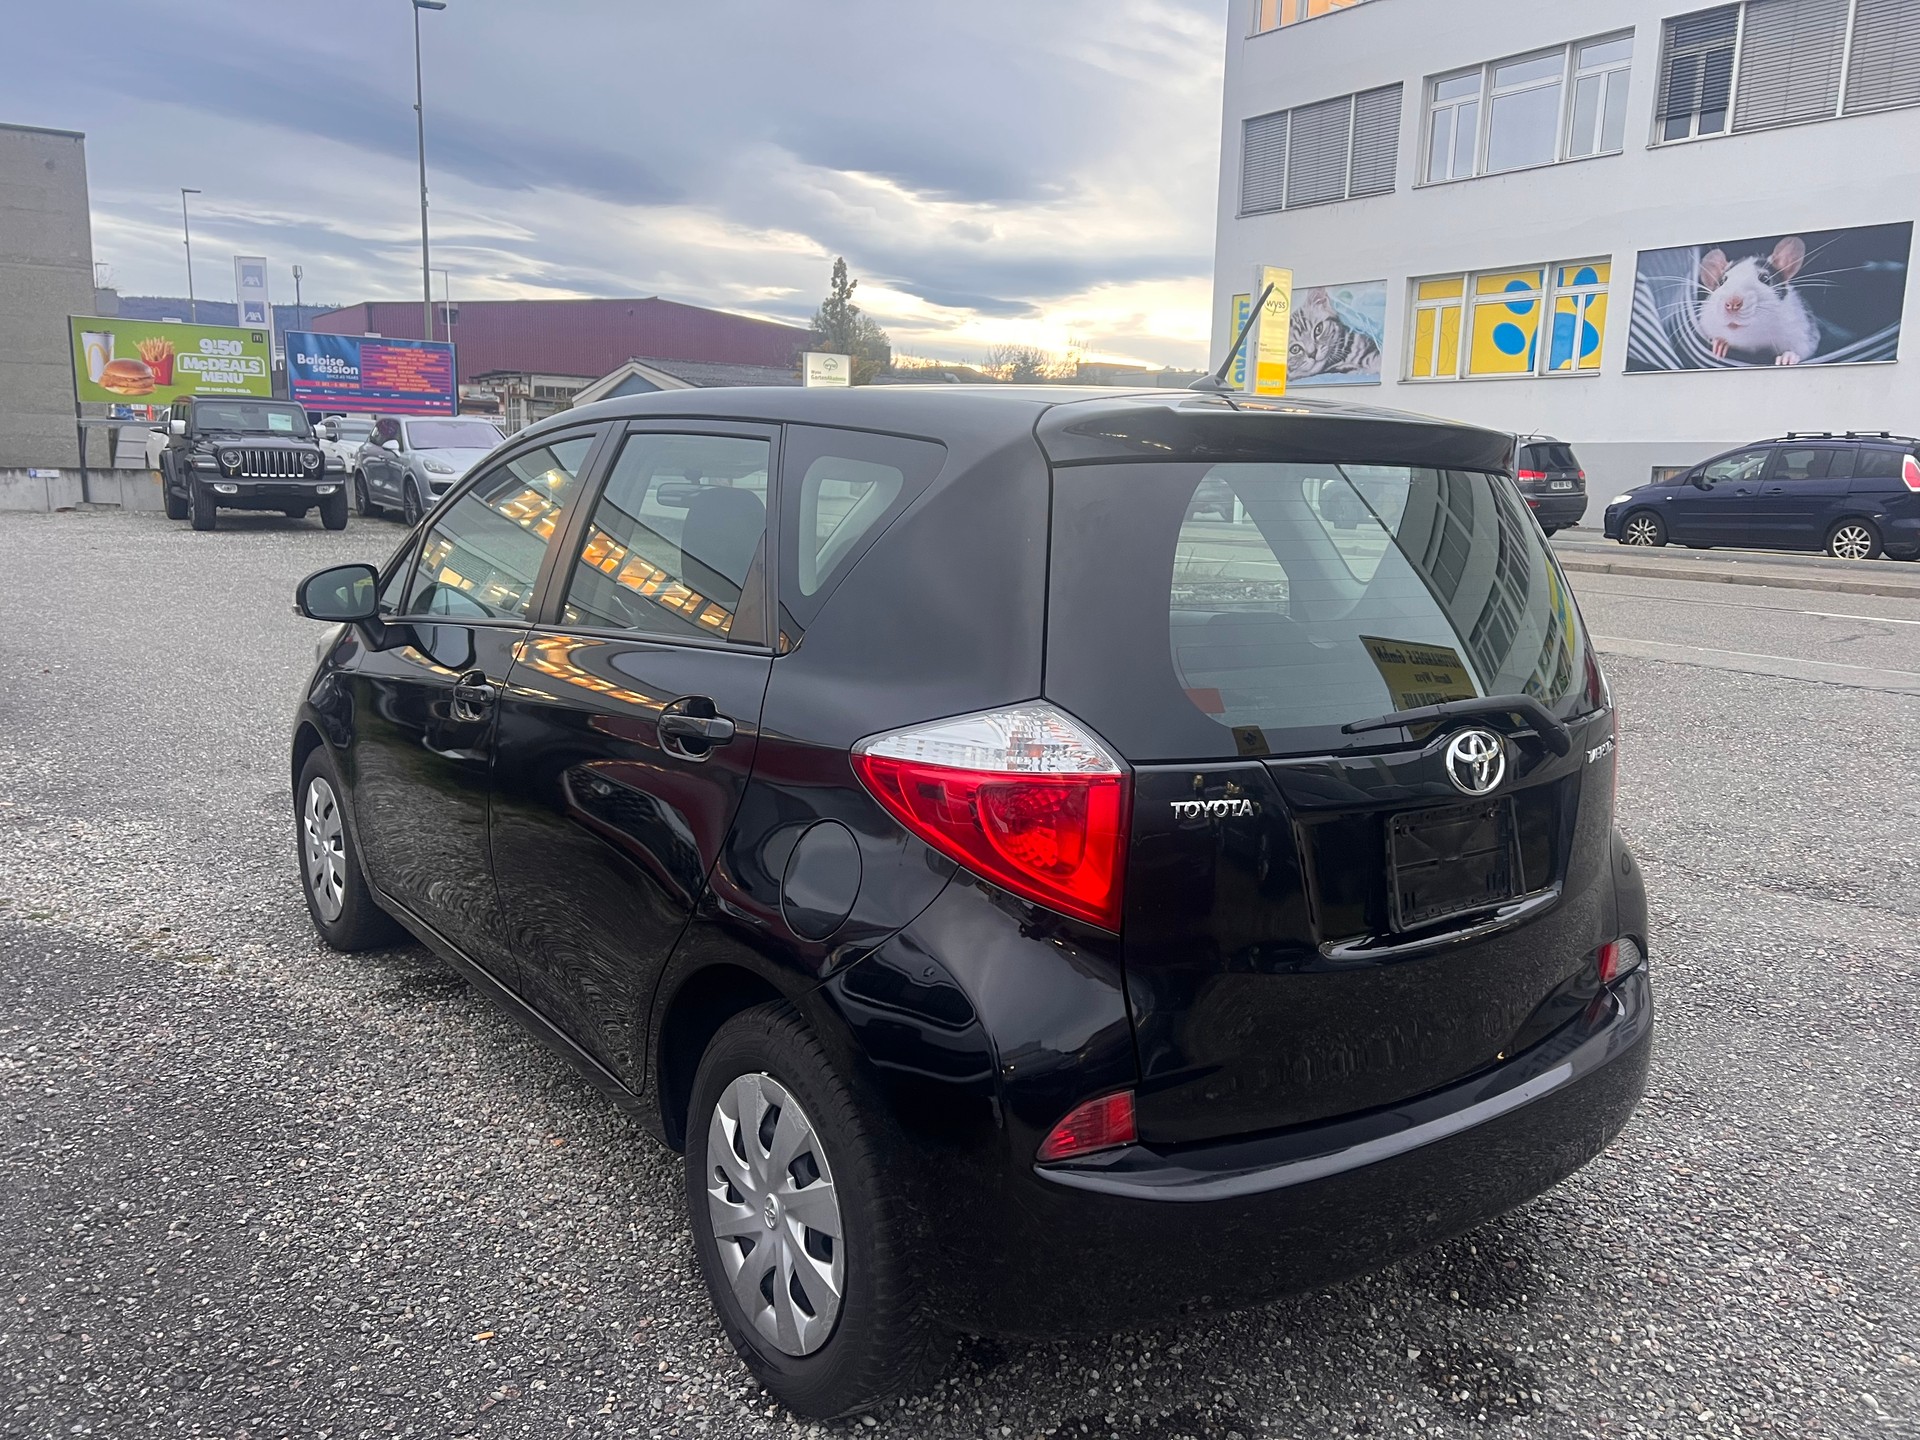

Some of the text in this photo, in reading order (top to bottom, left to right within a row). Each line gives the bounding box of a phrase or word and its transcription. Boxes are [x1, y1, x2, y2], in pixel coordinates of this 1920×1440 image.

[1266, 300, 1286, 316] wyss
[245, 311, 263, 321] AXA
[183, 357, 260, 373] McDEALS
[296, 353, 345, 367] Baloise
[312, 365, 359, 375] session
[201, 371, 244, 384] MENU
[1170, 798, 1254, 820] TOYOTA
